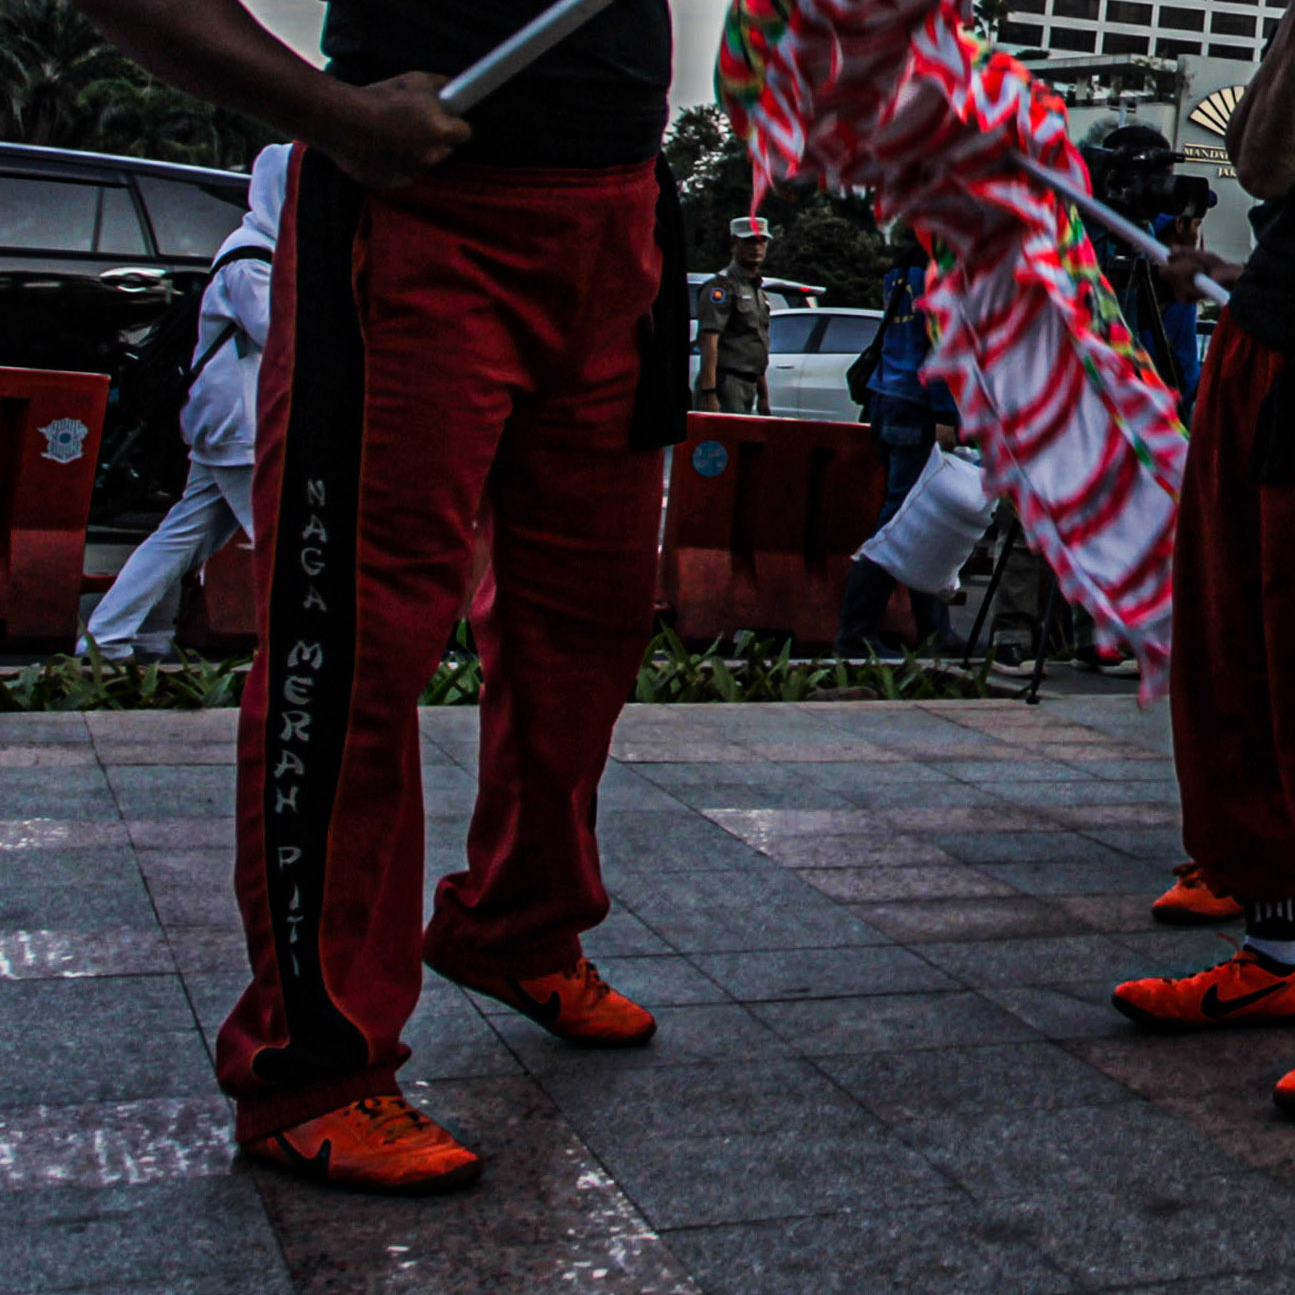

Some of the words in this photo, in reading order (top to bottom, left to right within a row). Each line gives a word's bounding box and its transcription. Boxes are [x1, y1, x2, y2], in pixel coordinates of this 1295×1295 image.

[1217, 166, 1237, 178] JAK
[301, 477, 329, 613] NAGA
[273, 640, 324, 816] MERAH
